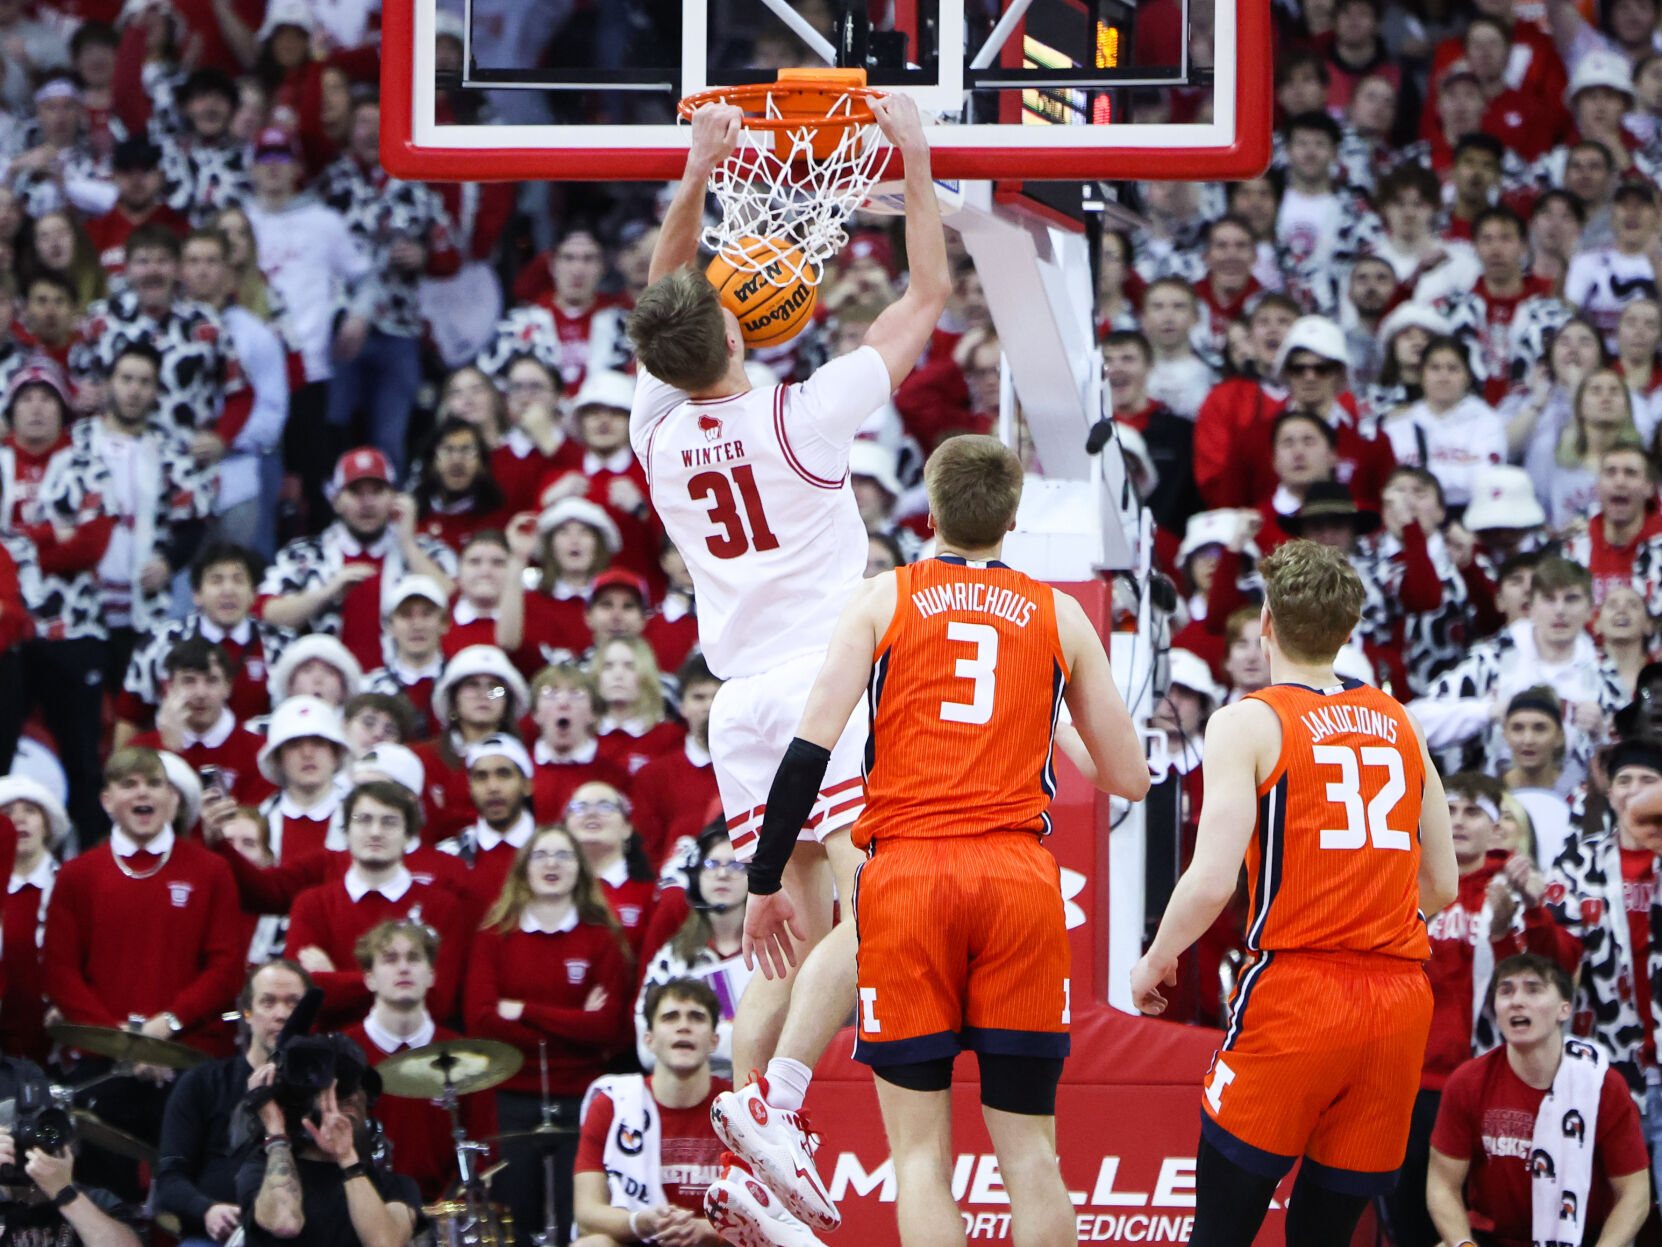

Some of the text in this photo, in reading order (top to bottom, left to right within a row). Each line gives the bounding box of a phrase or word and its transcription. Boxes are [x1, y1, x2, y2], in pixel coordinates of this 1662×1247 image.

[745, 284, 810, 332] Wilson
[681, 440, 744, 468] WINTER
[687, 464, 780, 559] 31
[912, 583, 1037, 627] HUMRICHOUS
[939, 621, 999, 725] 3
[1300, 705, 1398, 744] JAKUCIONIS
[1312, 745, 1411, 851] 32
[1076, 1214, 1196, 1242] EDICINE
